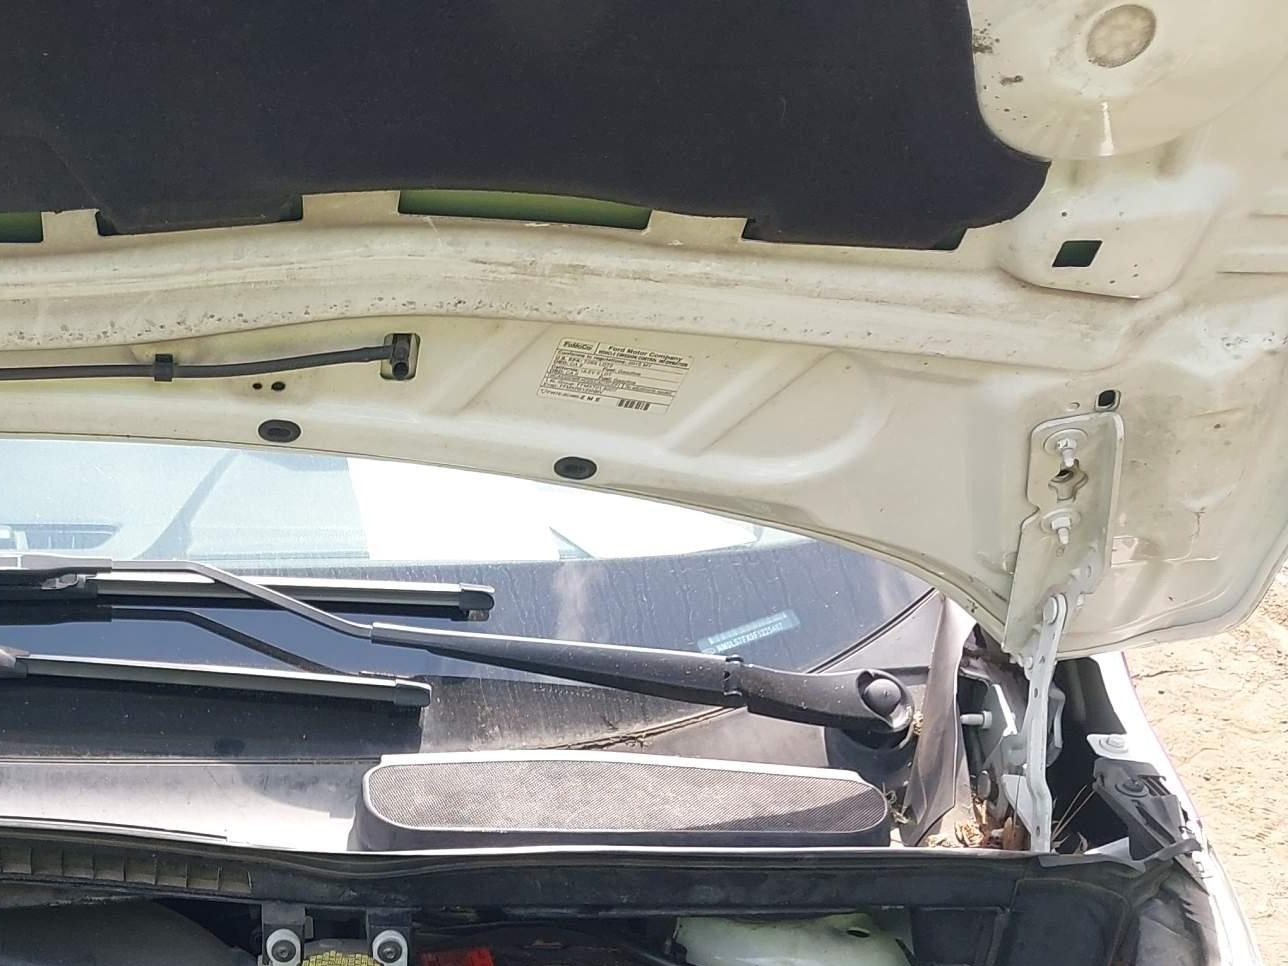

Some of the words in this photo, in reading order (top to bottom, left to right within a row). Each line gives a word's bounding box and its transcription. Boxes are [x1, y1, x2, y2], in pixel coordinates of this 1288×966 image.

[608, 345, 626, 353] Ford
[626, 347, 648, 356] Motor
[649, 351, 684, 362] Company
